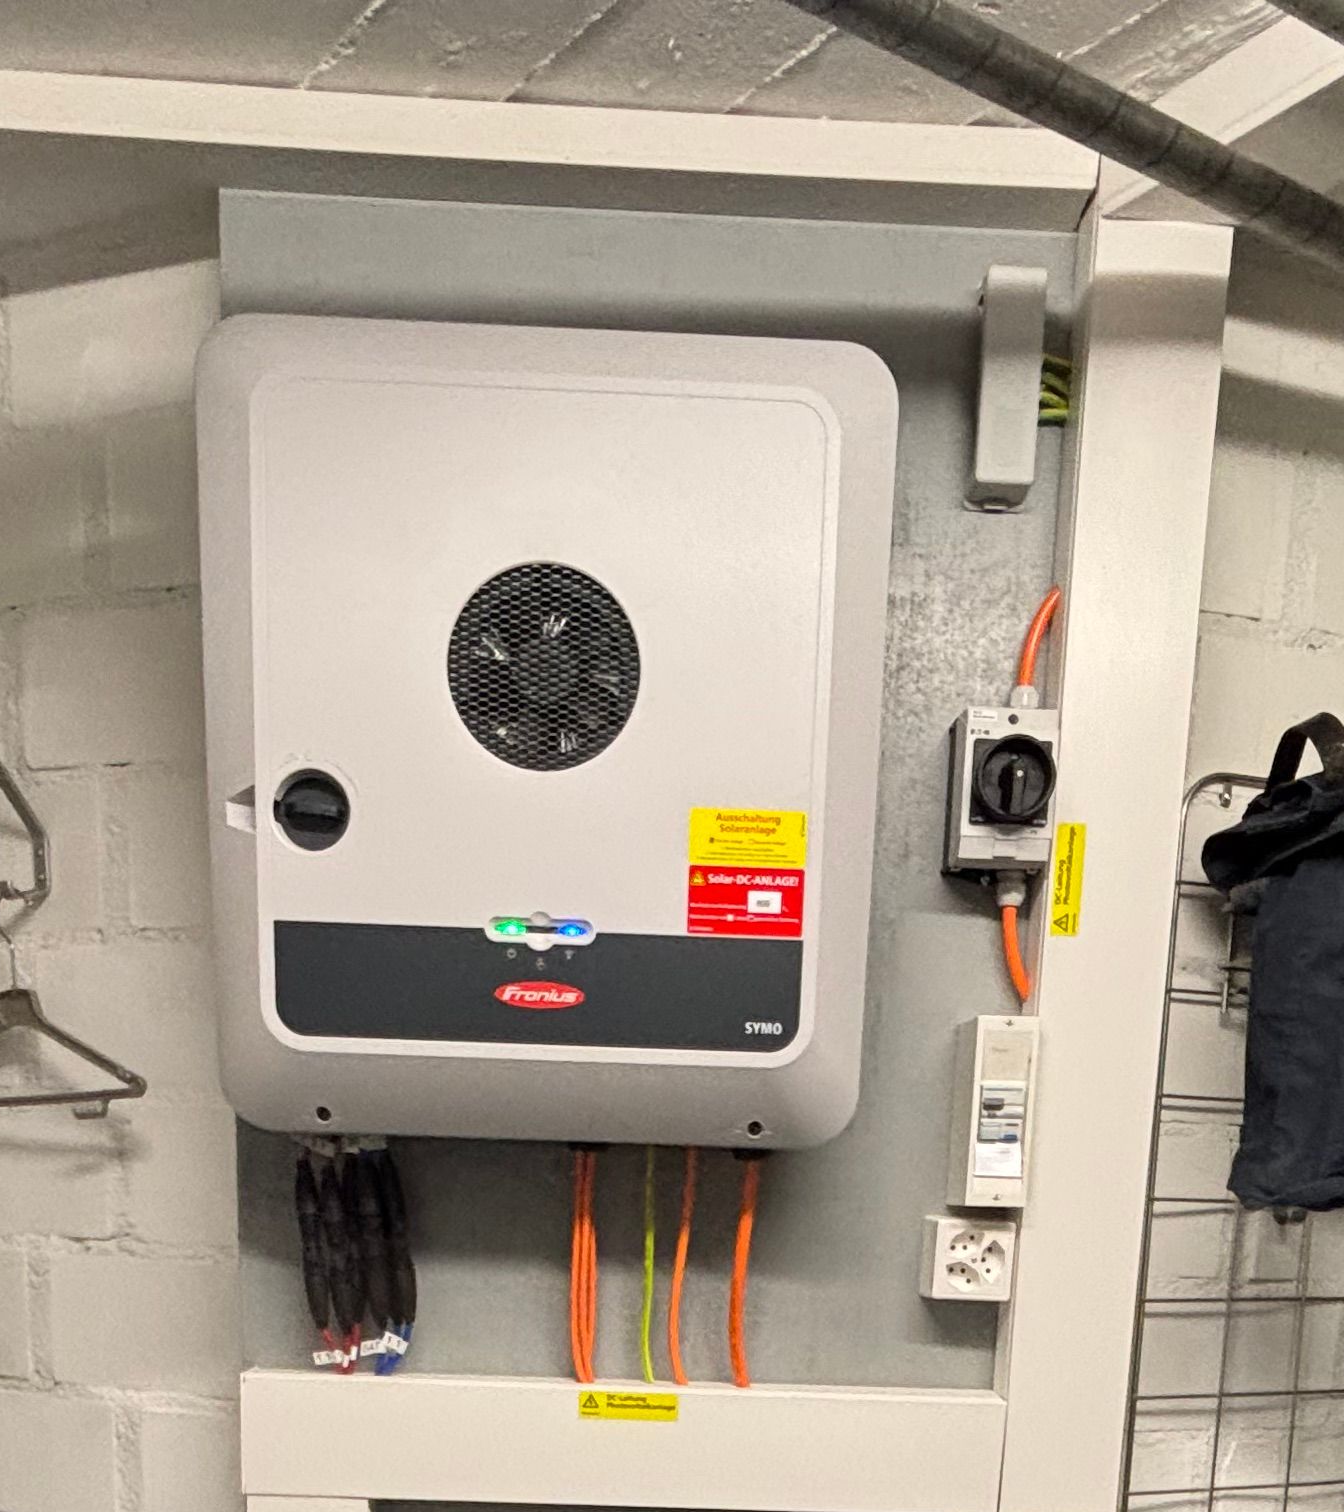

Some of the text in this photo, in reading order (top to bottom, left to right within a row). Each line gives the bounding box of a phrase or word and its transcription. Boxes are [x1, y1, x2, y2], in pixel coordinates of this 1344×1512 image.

[716, 813, 781, 825] Ausschaltung
[719, 824, 777, 836] Solaranlage
[503, 985, 577, 1003] Fronius
[744, 1021, 783, 1036] SYMO
